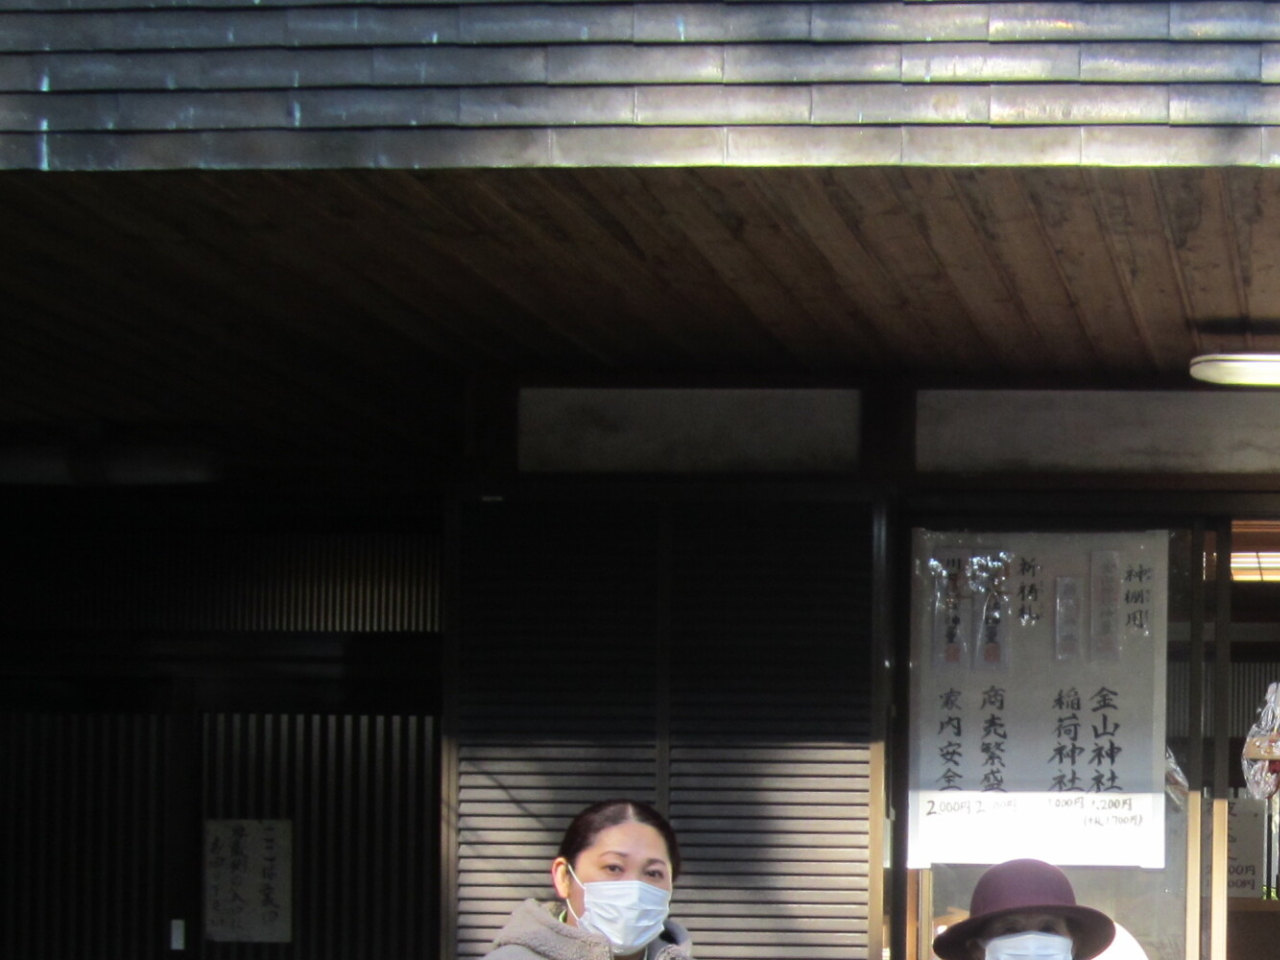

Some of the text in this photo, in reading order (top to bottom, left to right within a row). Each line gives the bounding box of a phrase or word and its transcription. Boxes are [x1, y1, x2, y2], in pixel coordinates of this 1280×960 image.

[936, 687, 963, 791] 家内安全
[980, 686, 1008, 793] 商売繁盛
[1048, 688, 1085, 793] 稲荷神社
[1088, 687, 1124, 793] 金山神社
